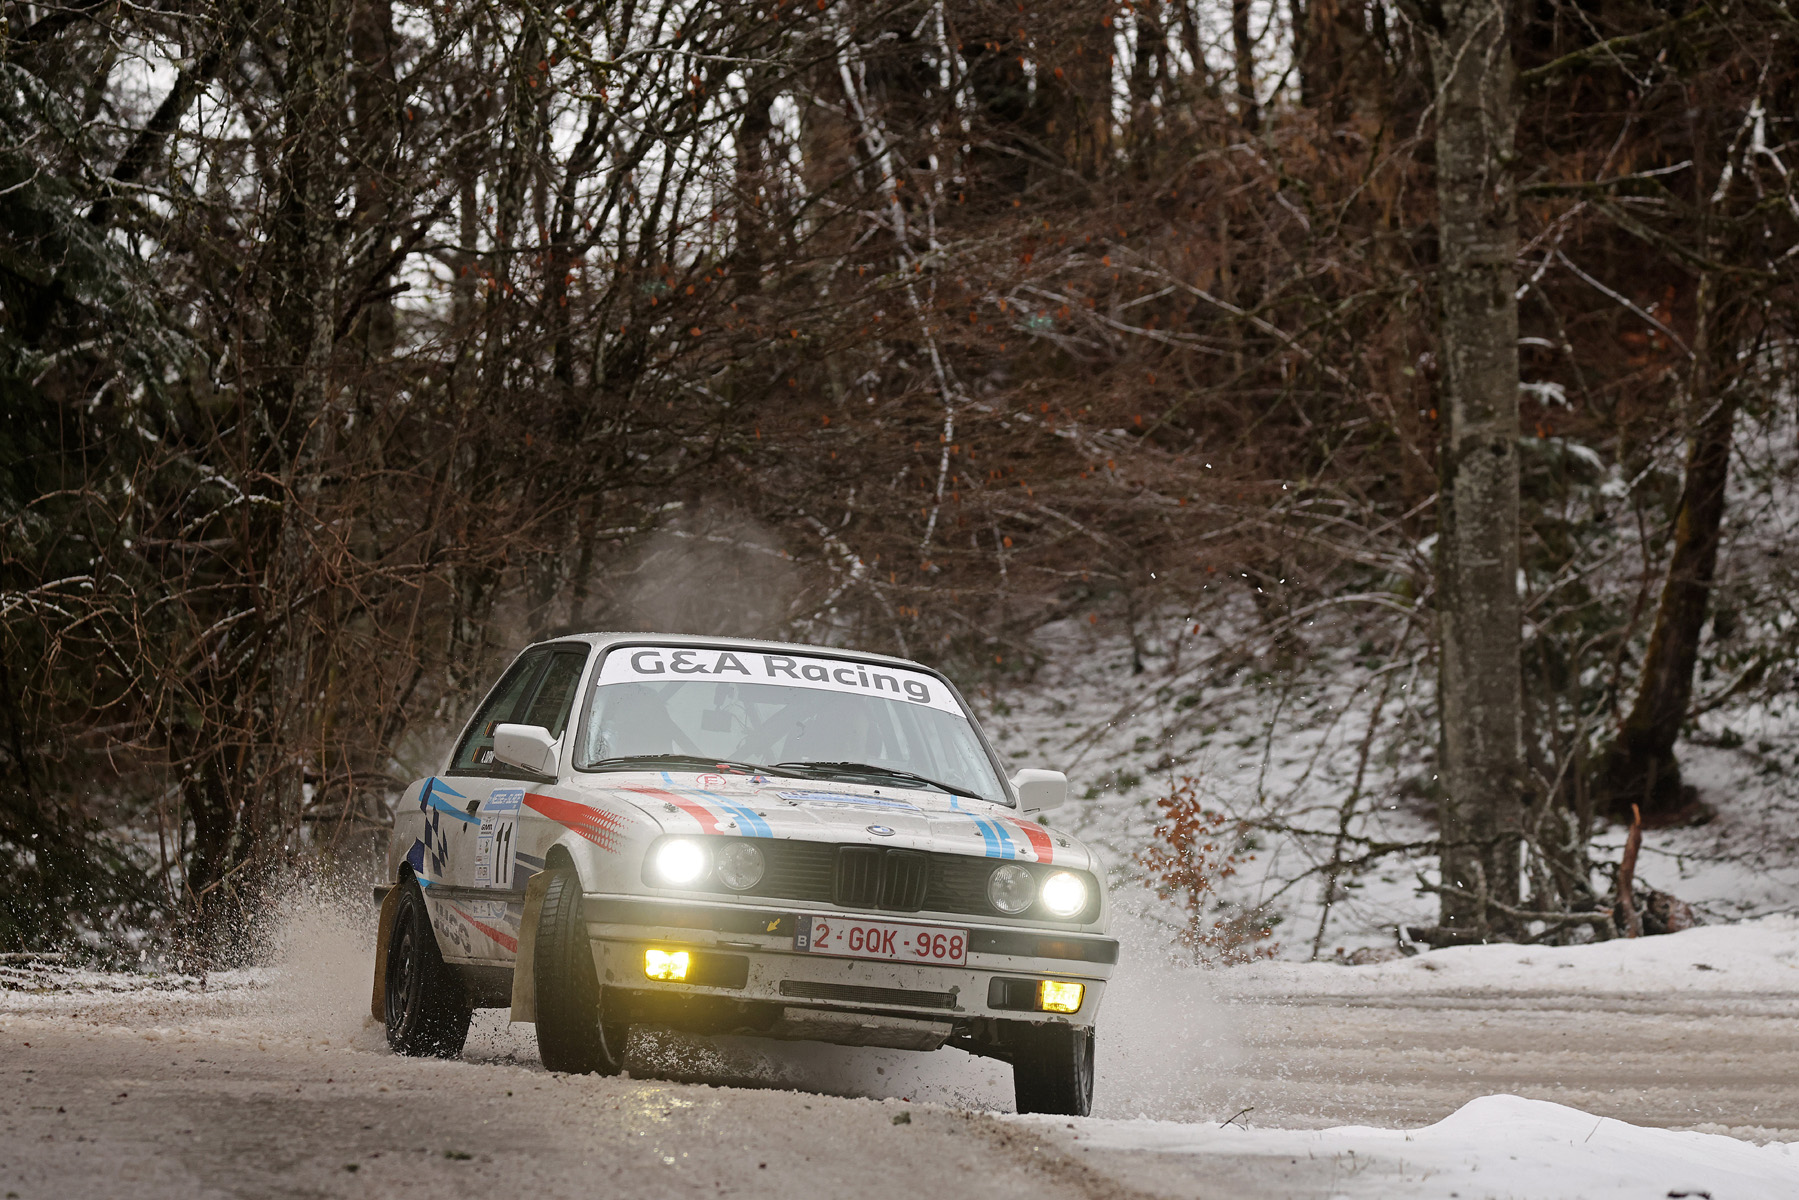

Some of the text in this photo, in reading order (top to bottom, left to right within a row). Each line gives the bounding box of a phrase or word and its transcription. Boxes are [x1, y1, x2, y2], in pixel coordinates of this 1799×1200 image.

[630, 650, 931, 704] G&A Racing
[496, 821, 513, 884] 11
[797, 935, 808, 947] B
